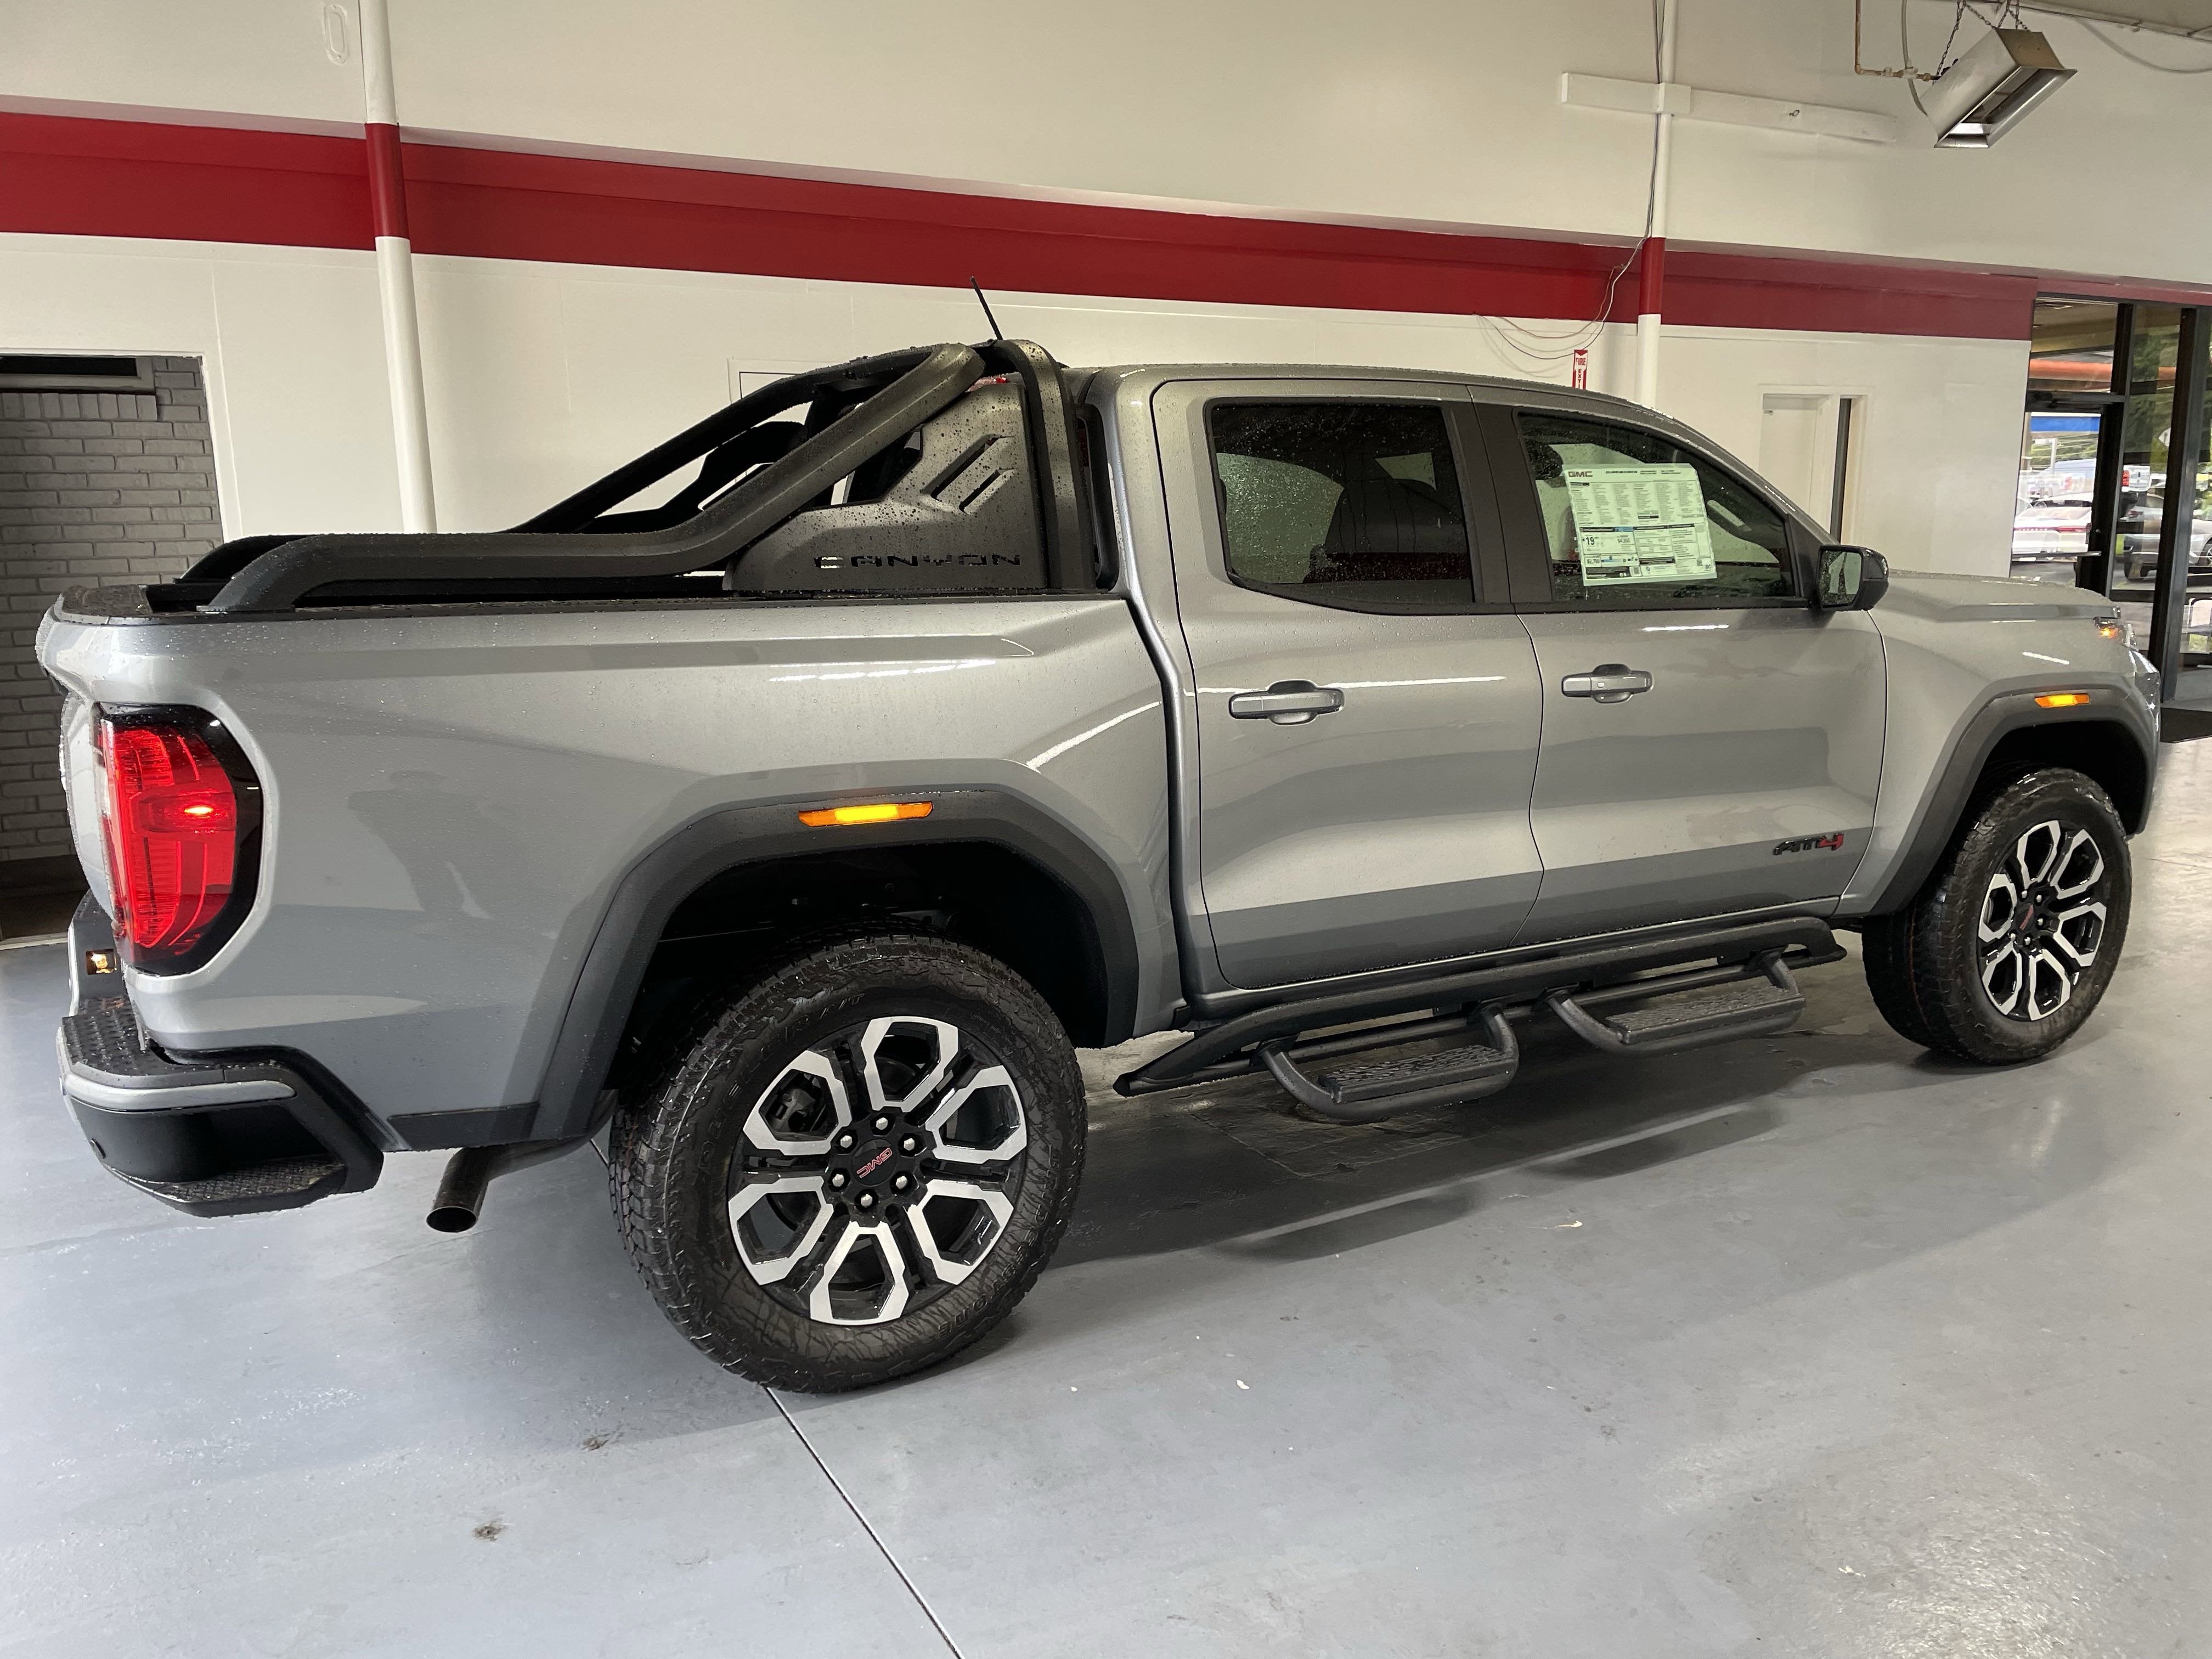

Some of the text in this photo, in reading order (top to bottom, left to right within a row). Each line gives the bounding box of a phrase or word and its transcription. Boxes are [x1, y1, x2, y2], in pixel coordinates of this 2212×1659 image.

[1586, 537, 1595, 545] 19
[814, 554, 1021, 569] CANYON
[1773, 833, 1844, 855] AT4
[856, 1147, 893, 1179] GMC
